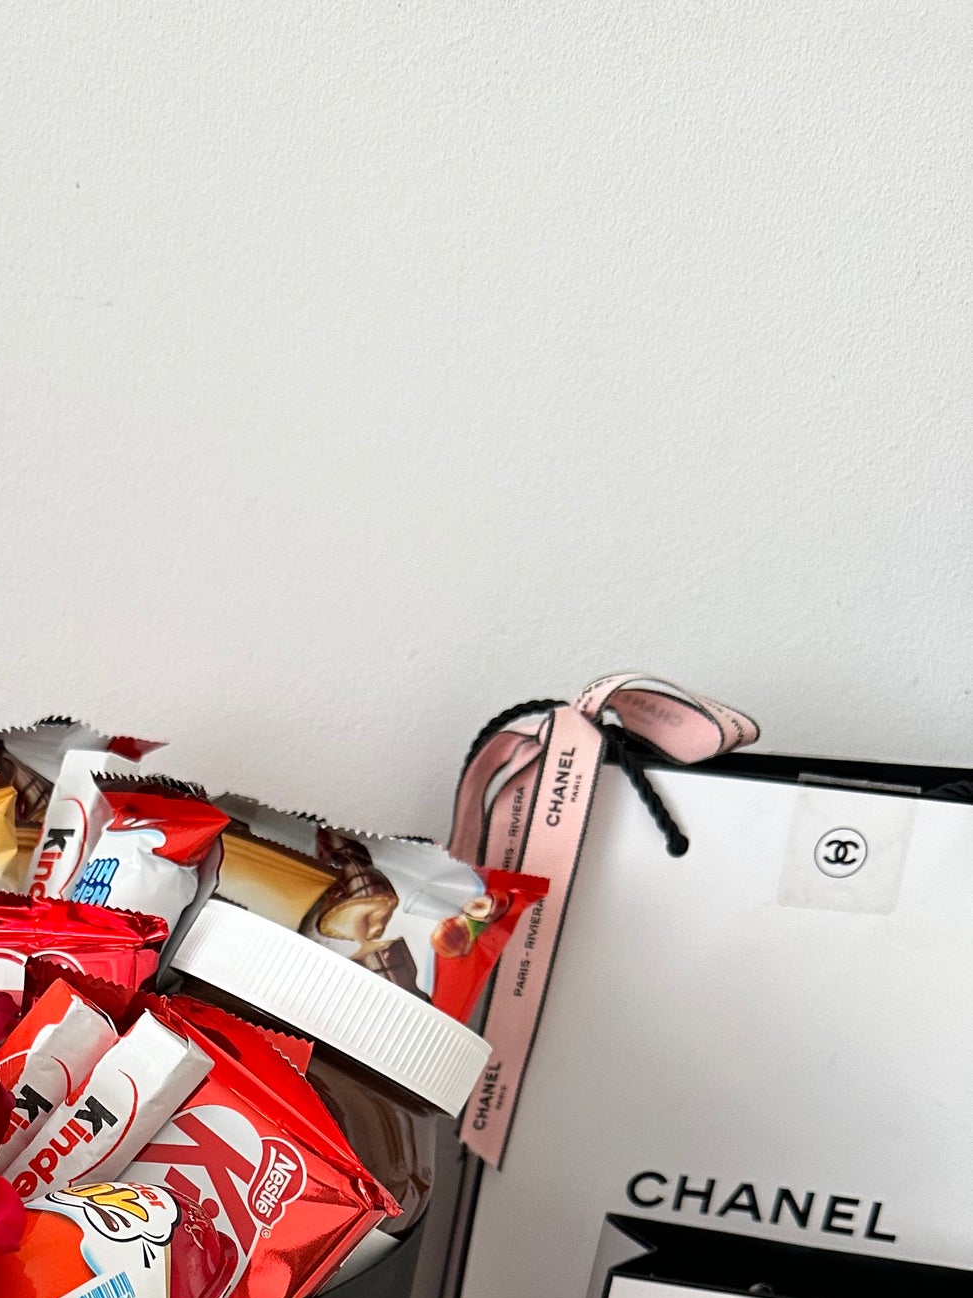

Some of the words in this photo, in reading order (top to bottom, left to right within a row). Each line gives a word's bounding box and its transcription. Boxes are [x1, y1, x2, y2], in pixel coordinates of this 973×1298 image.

[508, 786, 526, 838] RIVIERA
[545, 746, 576, 828] CHANEL
[570, 774, 583, 804] PARIS
[514, 959, 532, 998] PARIS
[524, 898, 545, 951] RIVIERA
[473, 1061, 502, 1131] CHANEL
[625, 1170, 897, 1243] CHANEL
